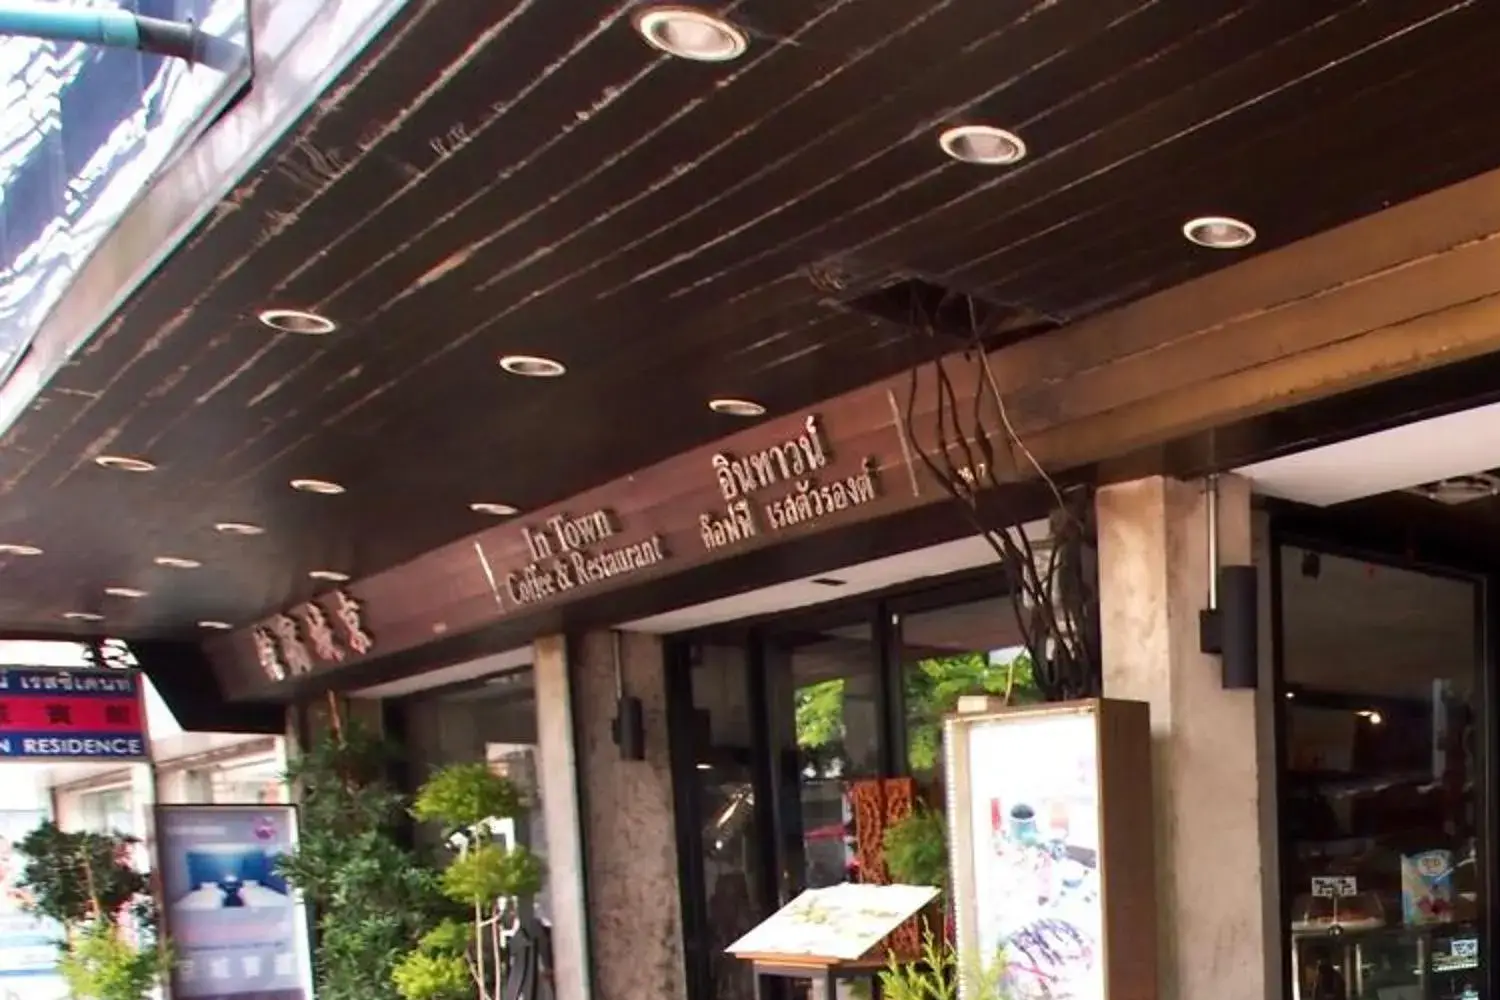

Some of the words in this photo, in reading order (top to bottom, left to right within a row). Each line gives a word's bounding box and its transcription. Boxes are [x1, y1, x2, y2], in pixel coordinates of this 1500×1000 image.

[520, 527, 552, 562] In
[546, 510, 613, 550] Town
[506, 563, 556, 605] Coffee
[570, 535, 664, 586] Restaurant
[22, 737, 141, 754] RESIDENCE
